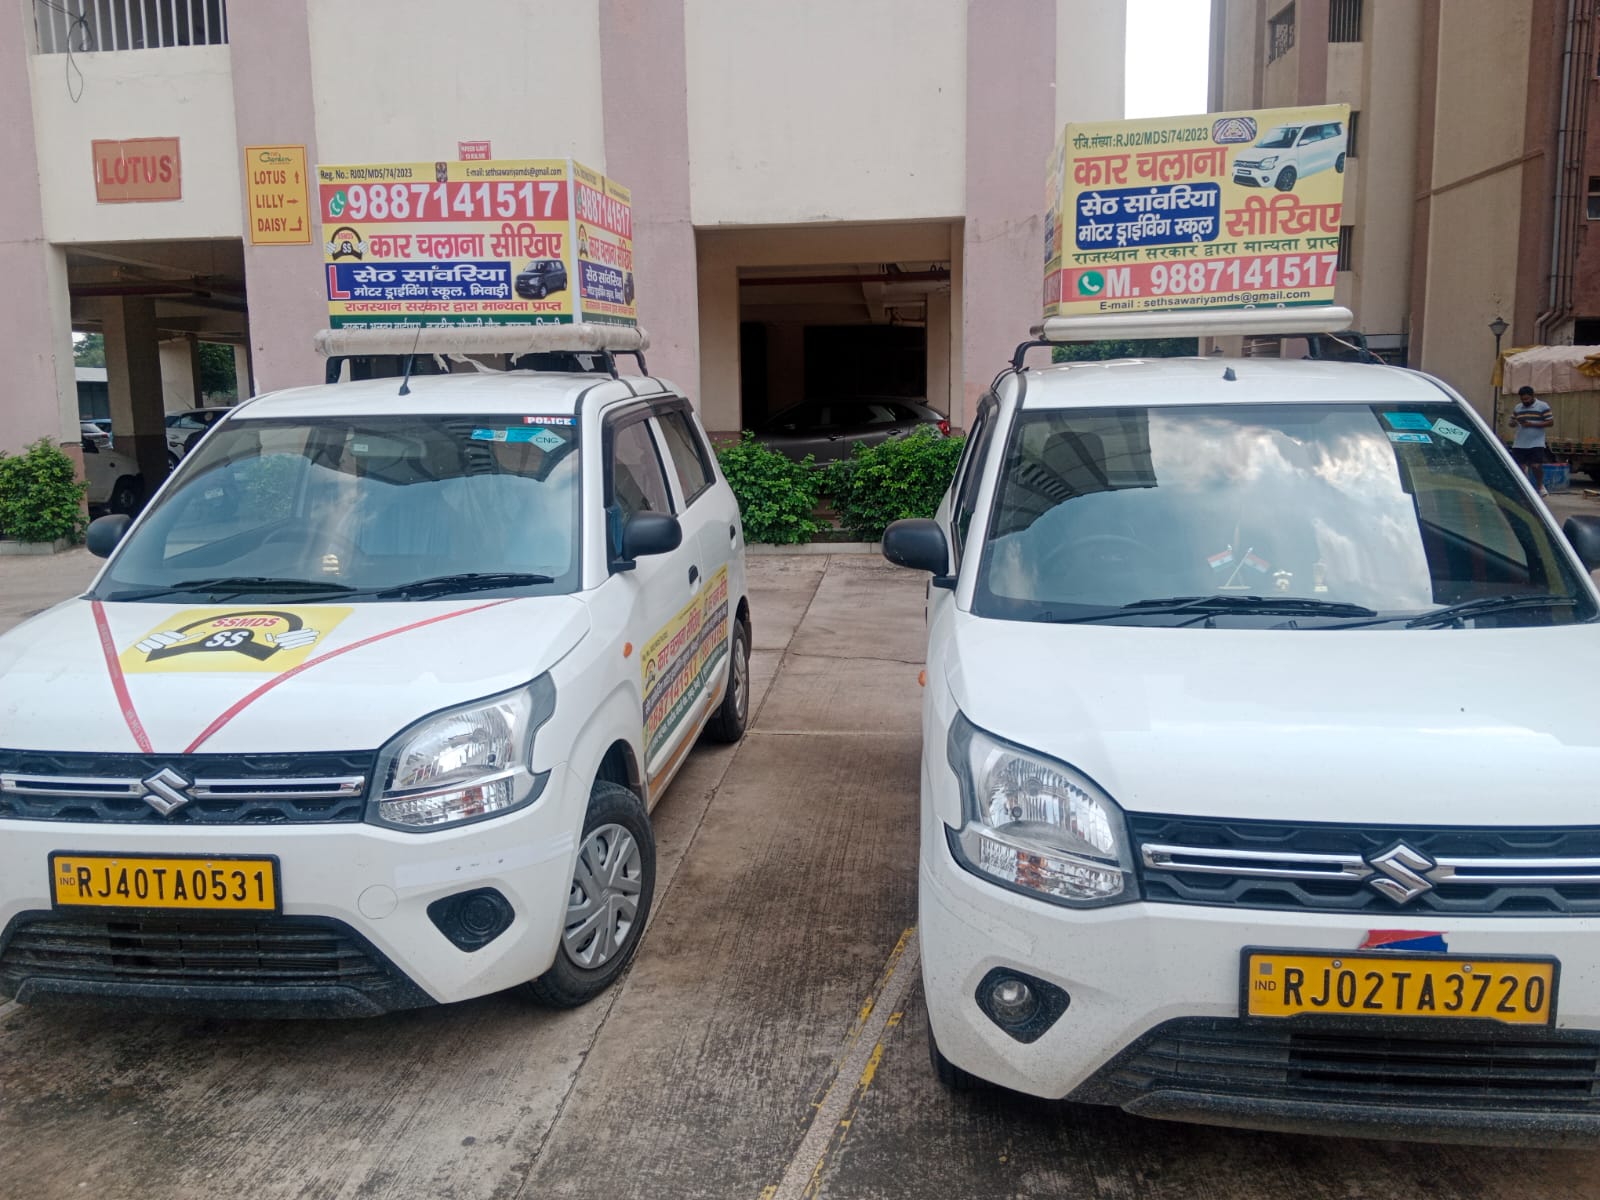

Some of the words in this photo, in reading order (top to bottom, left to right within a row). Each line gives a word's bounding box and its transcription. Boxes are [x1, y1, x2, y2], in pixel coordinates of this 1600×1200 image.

[101, 155, 172, 184] LOTUS
[254, 170, 286, 184] LOTUS
[320, 169, 335, 181] Reg.
[350, 168, 412, 180] RJ02/MDS/74/2023
[1073, 154, 1131, 186] कार
[1136, 147, 1228, 182] चलाना
[256, 194, 284, 208] LILLY
[348, 182, 558, 220] 9887141517
[1080, 192, 1119, 216] सेठ
[1123, 185, 1218, 213] सांवरिया
[258, 217, 287, 232] DAISY
[1224, 193, 1343, 237] सीखिए
[1078, 218, 1114, 242] मोटर
[1116, 214, 1171, 246] ड्राईविंग
[1174, 216, 1214, 243] स्कूल
[369, 234, 412, 259] कार
[416, 233, 485, 260] चलाना
[490, 223, 563, 259] सीखिए
[1072, 249, 1139, 264] राजस्थान
[1145, 245, 1198, 260] सरकार
[1203, 242, 1237, 256] द्वारा
[1243, 239, 1300, 253] मान्यता
[328, 265, 350, 299] L
[353, 266, 397, 283] सेठ
[401, 264, 507, 283] सांवरिया
[1106, 267, 1140, 298] M.
[1151, 254, 1338, 294] 9887141517
[354, 283, 382, 297] मोटर
[469, 283, 510, 298] भिवाड़ी
[1100, 300, 1134, 310] E-mail
[1144, 290, 1310, 306] sethsawariyamds@gmail.com
[344, 302, 402, 312] राजस्थान
[405, 302, 449, 312] सरकार
[453, 302, 478, 312] द्वारा
[482, 302, 528, 312] मान्यता
[532, 302, 562, 313] प्राप्त
[527, 416, 572, 425] POLICE
[536, 436, 559, 444] CNG
[211, 618, 280, 628] SSMDS
[205, 631, 250, 648] SS
[60, 877, 76, 886] IND
[77, 866, 264, 902] RJ40TA0531
[1255, 980, 1277, 991] IND
[1284, 967, 1545, 1013] RJ02TA3720
